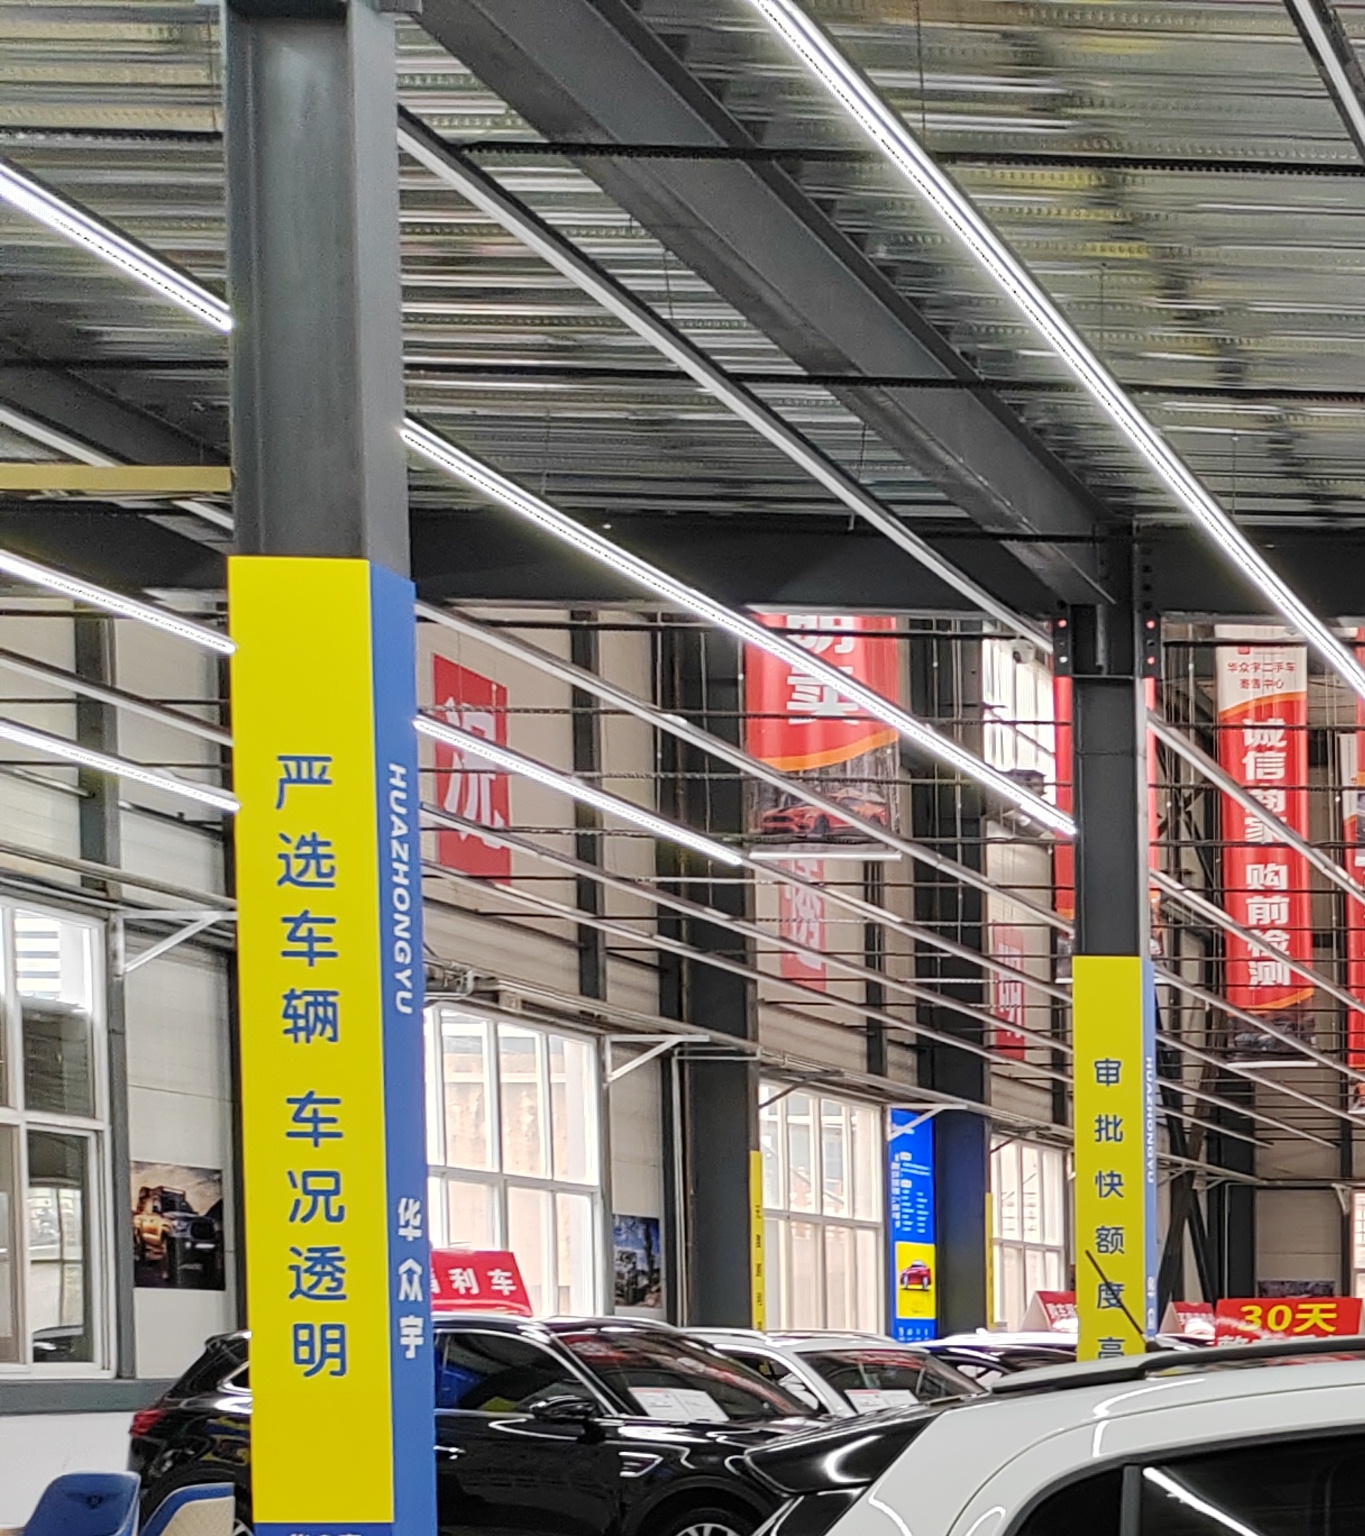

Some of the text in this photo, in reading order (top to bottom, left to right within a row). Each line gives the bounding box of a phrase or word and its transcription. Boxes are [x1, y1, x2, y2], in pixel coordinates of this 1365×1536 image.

[388, 762, 414, 1015] HUAZHONGYU
[275, 754, 349, 1378] 严选车辆 车况透明
[398, 1197, 424, 1359] 华众宇
[1240, 1303, 1338, 1333] 30天
